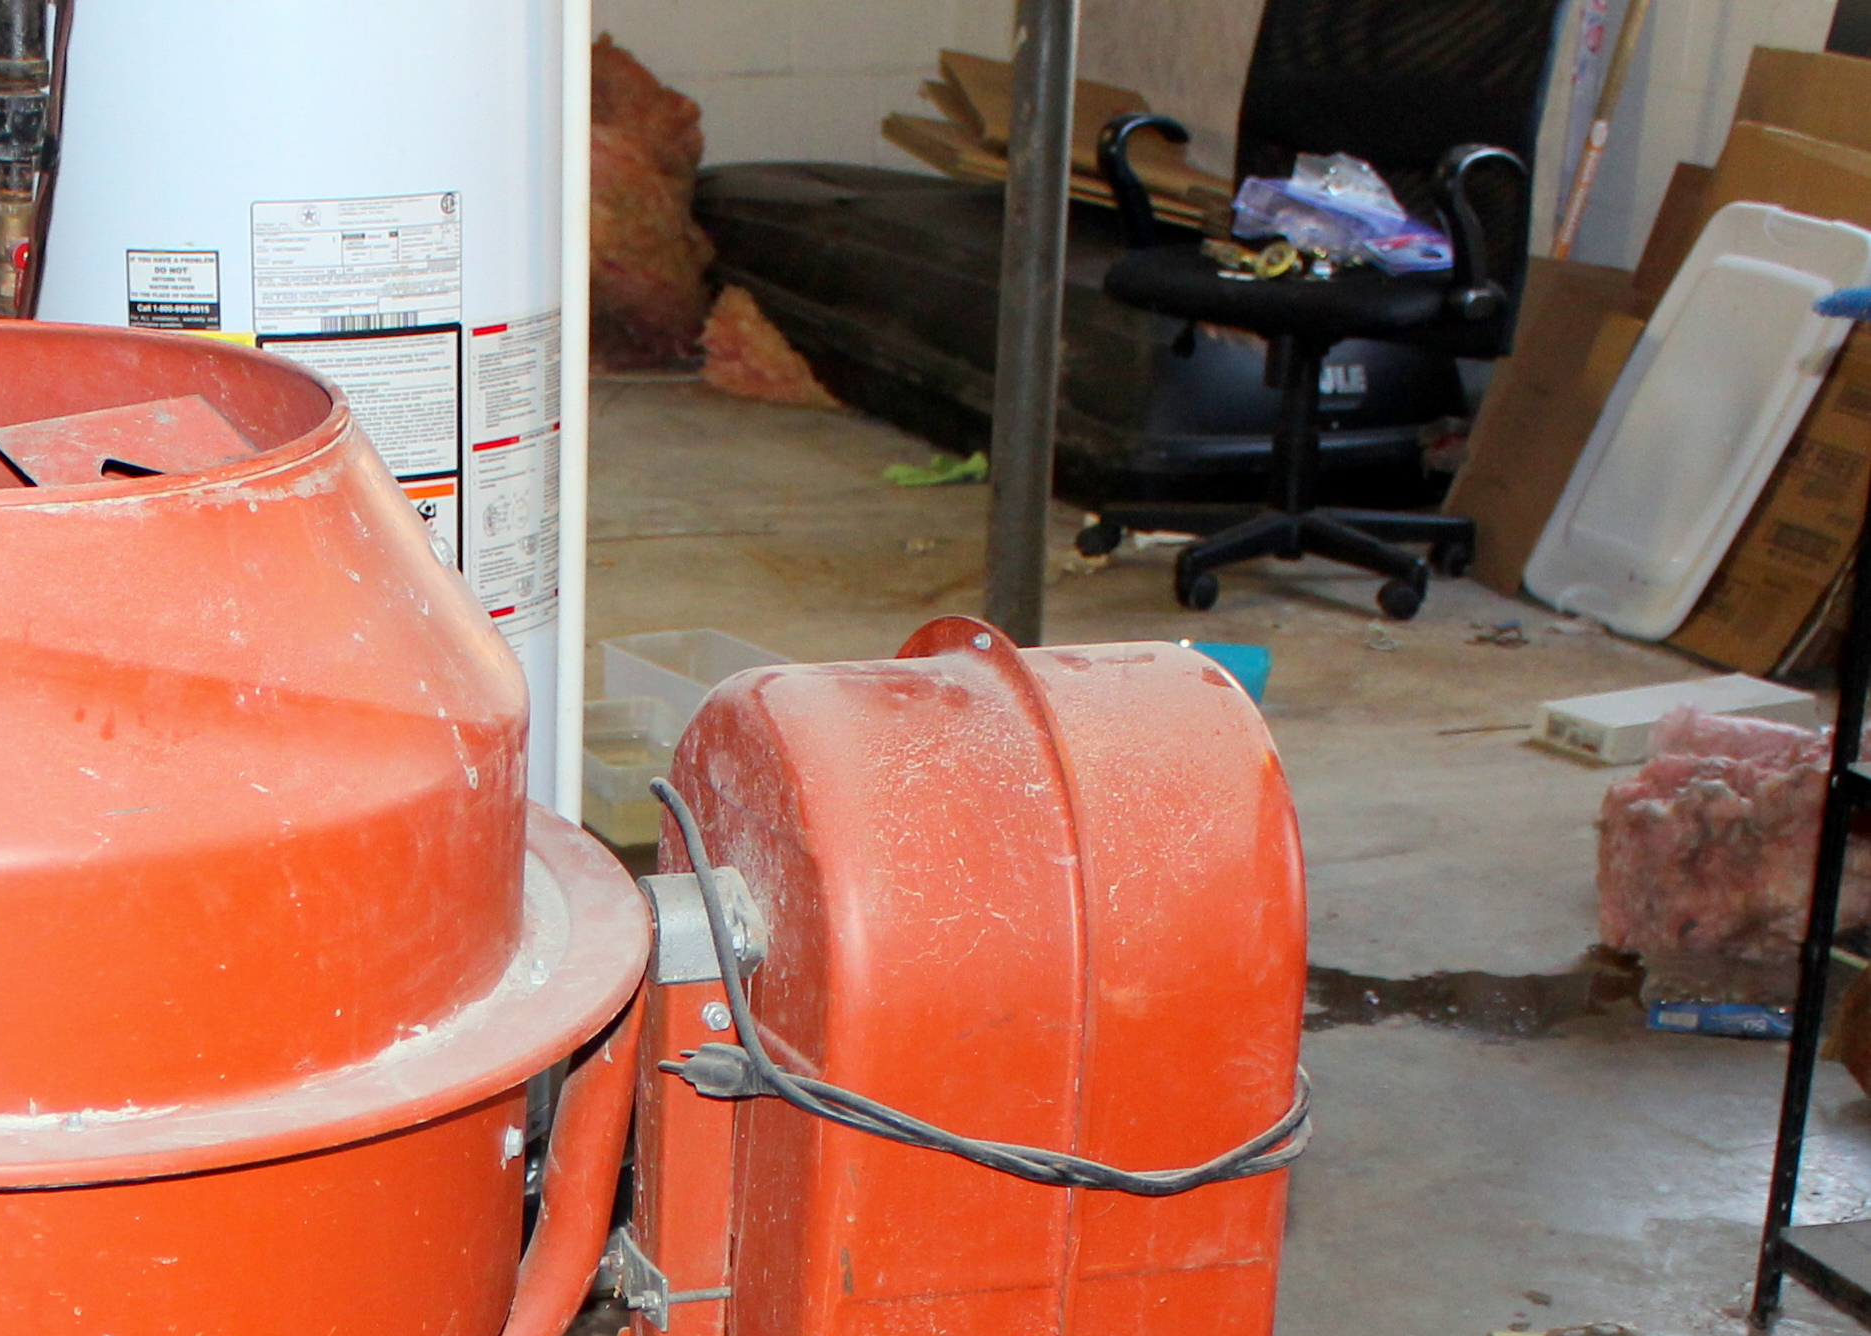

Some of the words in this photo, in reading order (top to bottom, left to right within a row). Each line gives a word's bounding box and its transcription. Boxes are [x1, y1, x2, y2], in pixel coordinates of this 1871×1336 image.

[154, 266, 167, 274] DO
[170, 266, 188, 274] NOT
[136, 303, 151, 313] Call
